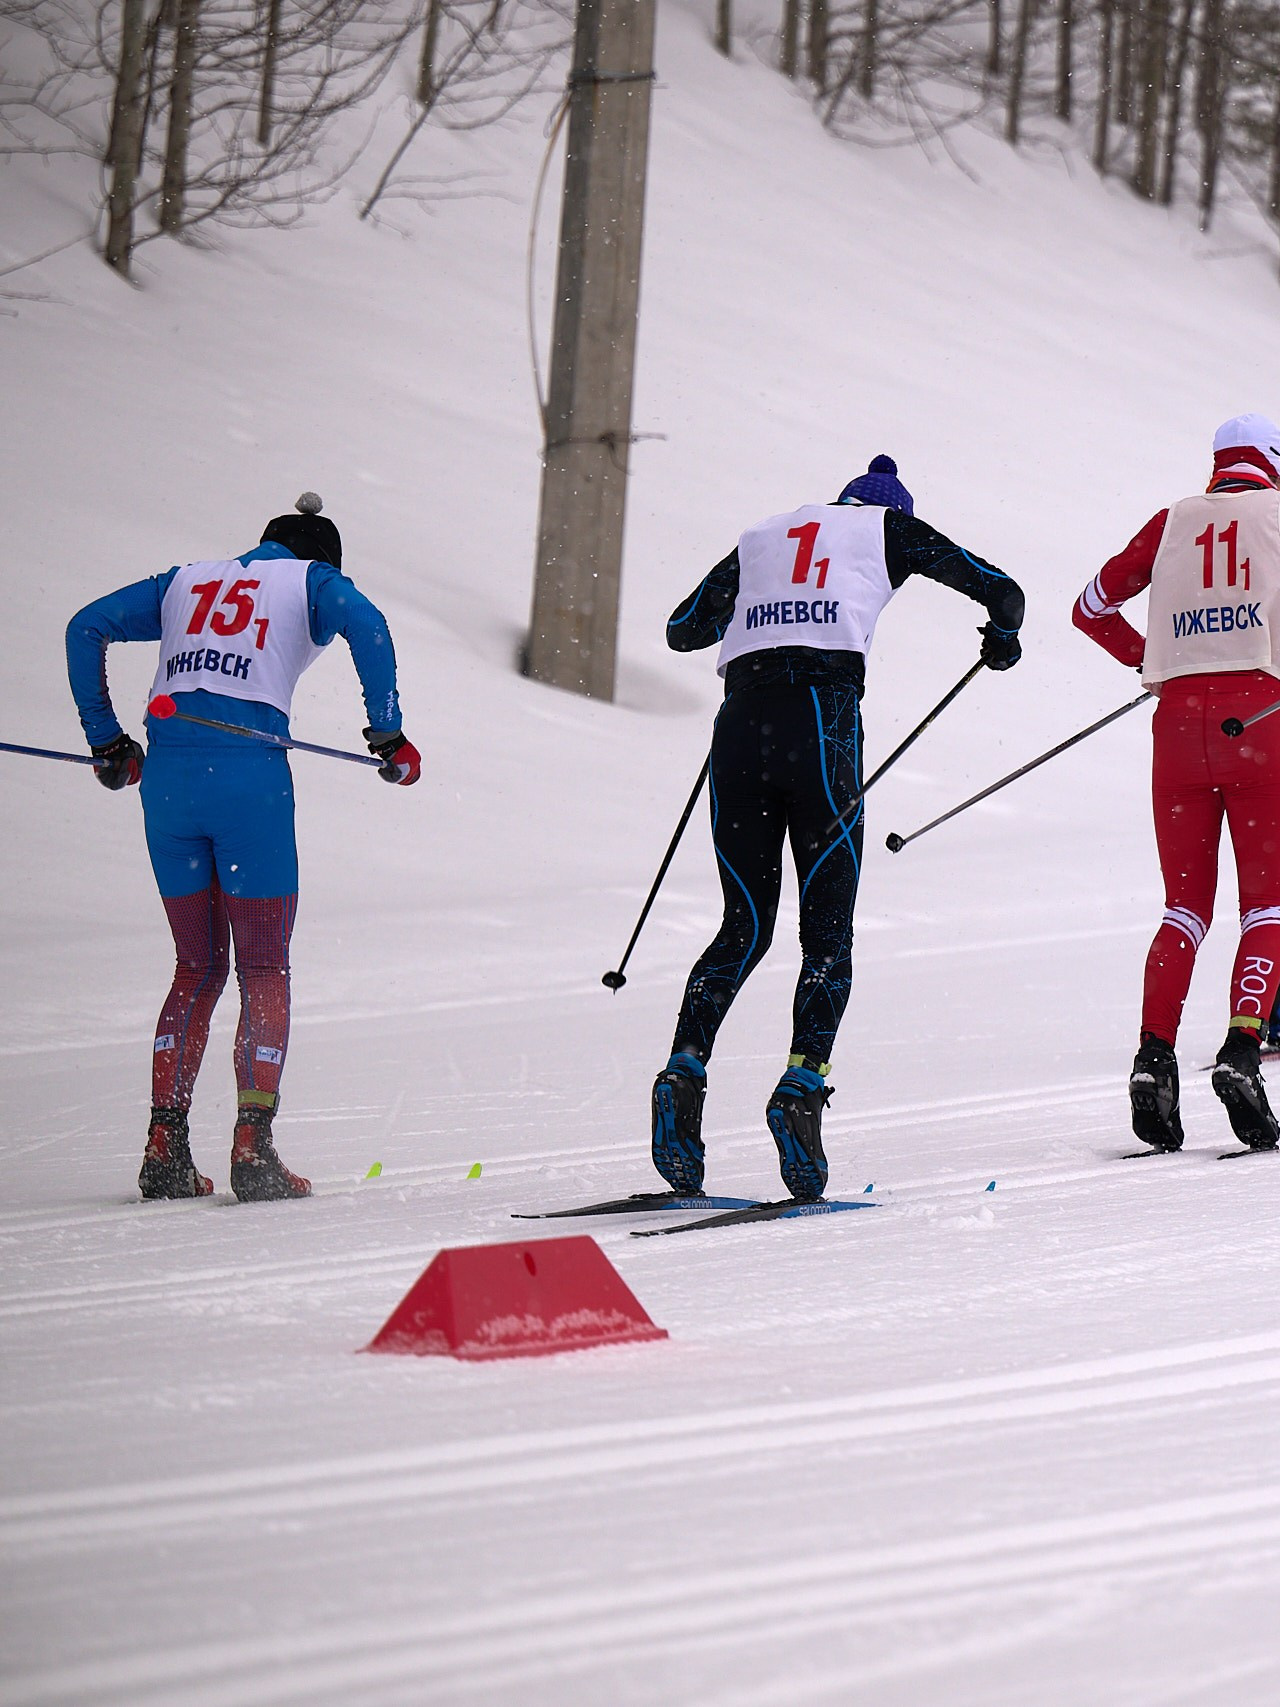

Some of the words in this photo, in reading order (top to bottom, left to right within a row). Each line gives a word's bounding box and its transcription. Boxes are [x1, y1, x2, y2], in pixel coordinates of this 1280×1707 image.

[746, 600, 840, 631] ИЖЕВСК
[1173, 602, 1262, 638] ИЖЕВСК
[166, 647, 253, 682] ИЖЕВСК
[1237, 956, 1274, 1015] ROC
